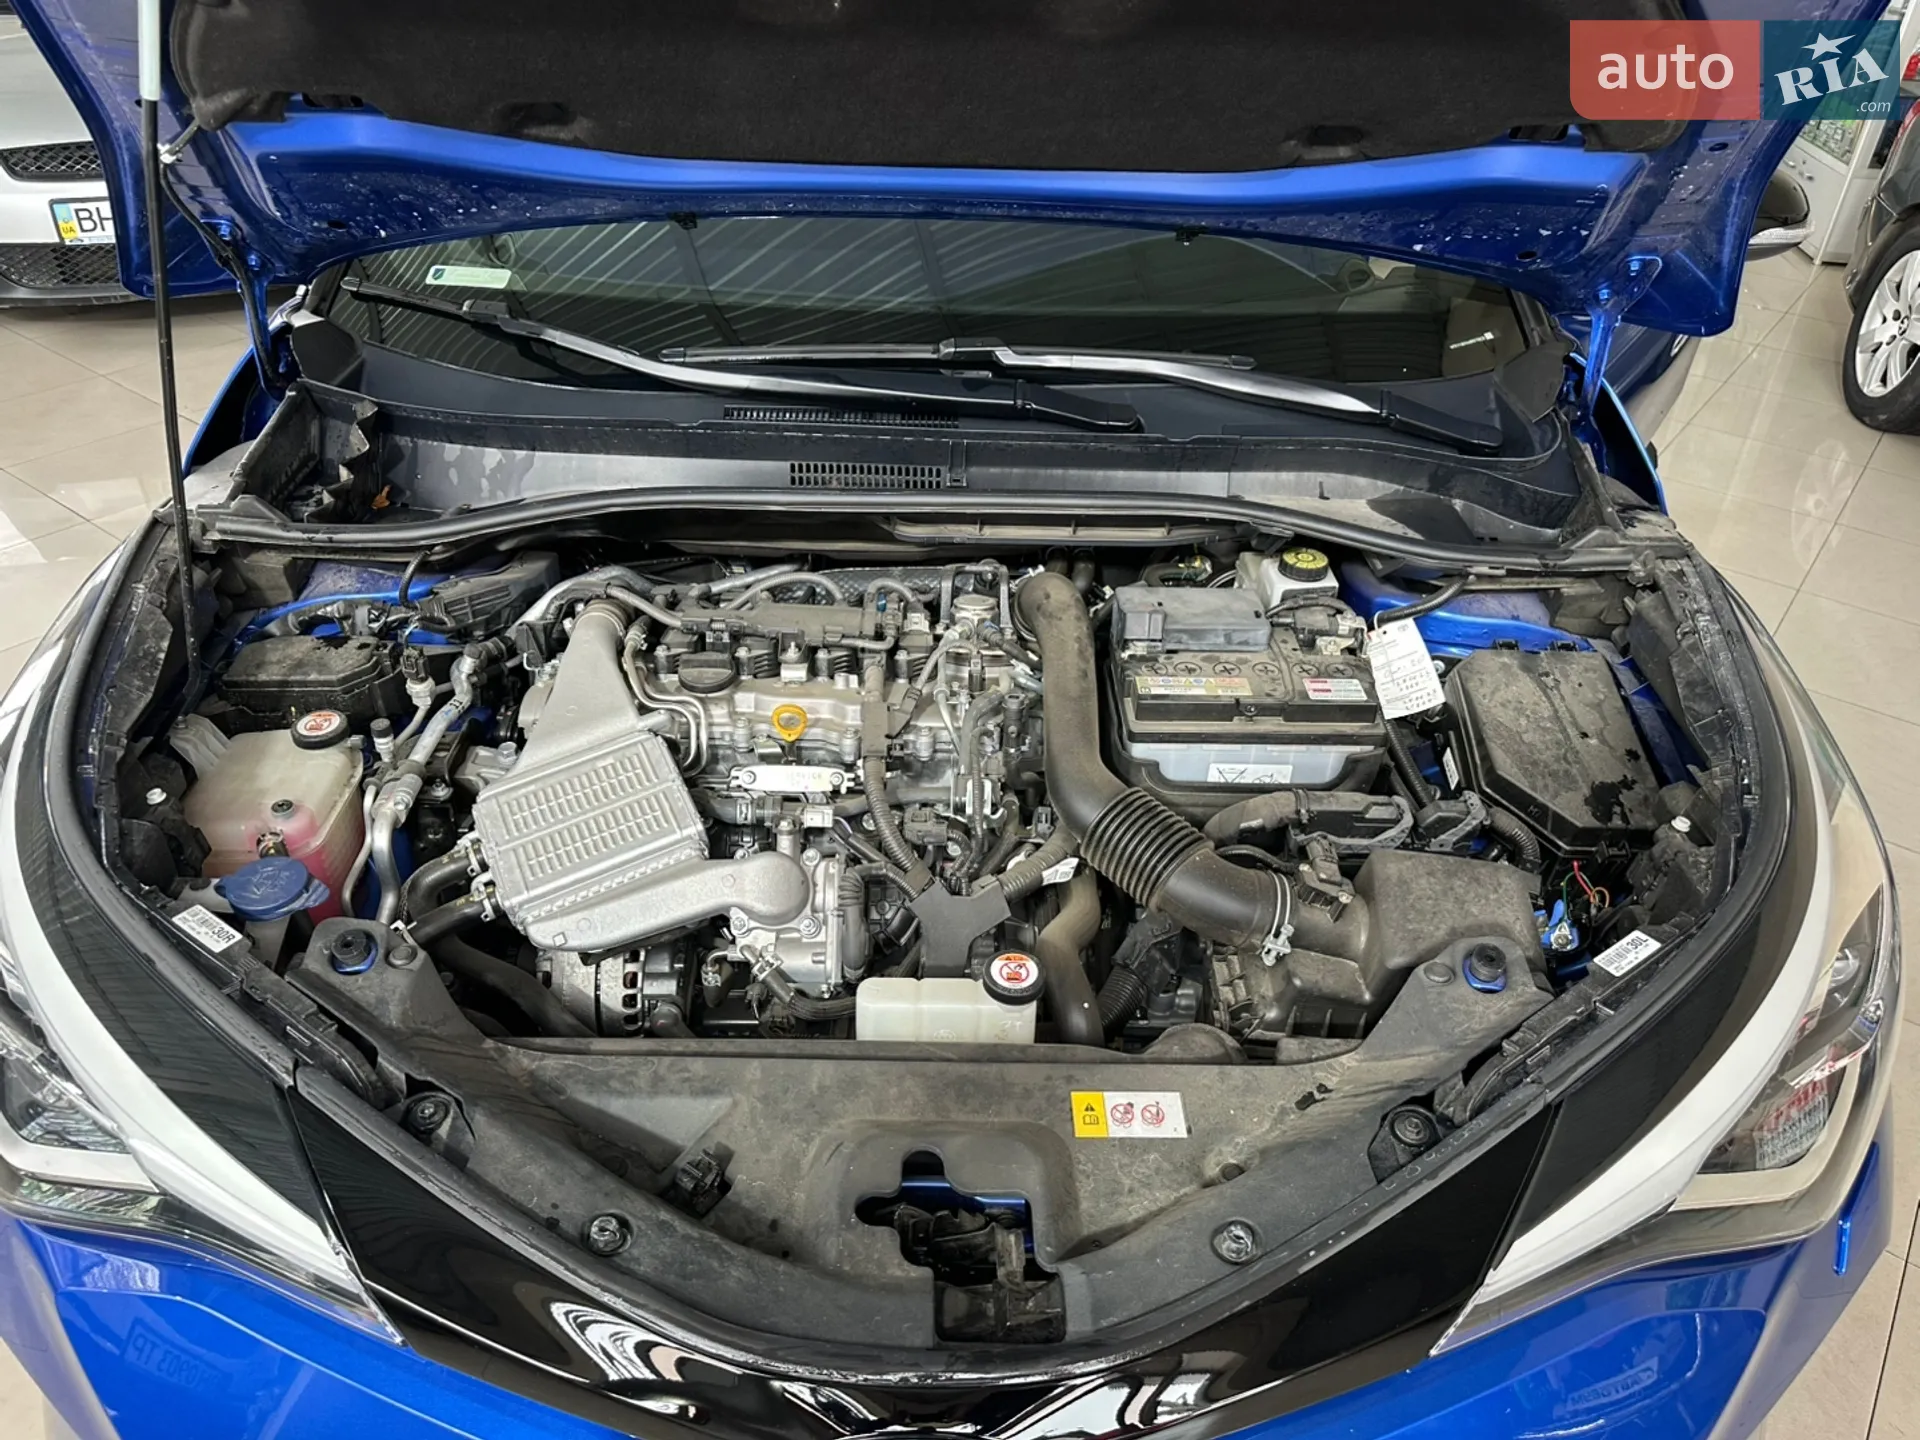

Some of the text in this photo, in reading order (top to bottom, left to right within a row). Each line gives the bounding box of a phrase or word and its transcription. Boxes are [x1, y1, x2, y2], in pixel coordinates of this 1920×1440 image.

[62, 226, 76, 235] UA
[212, 926, 236, 944] 30R
[1626, 935, 1650, 949] 30L
